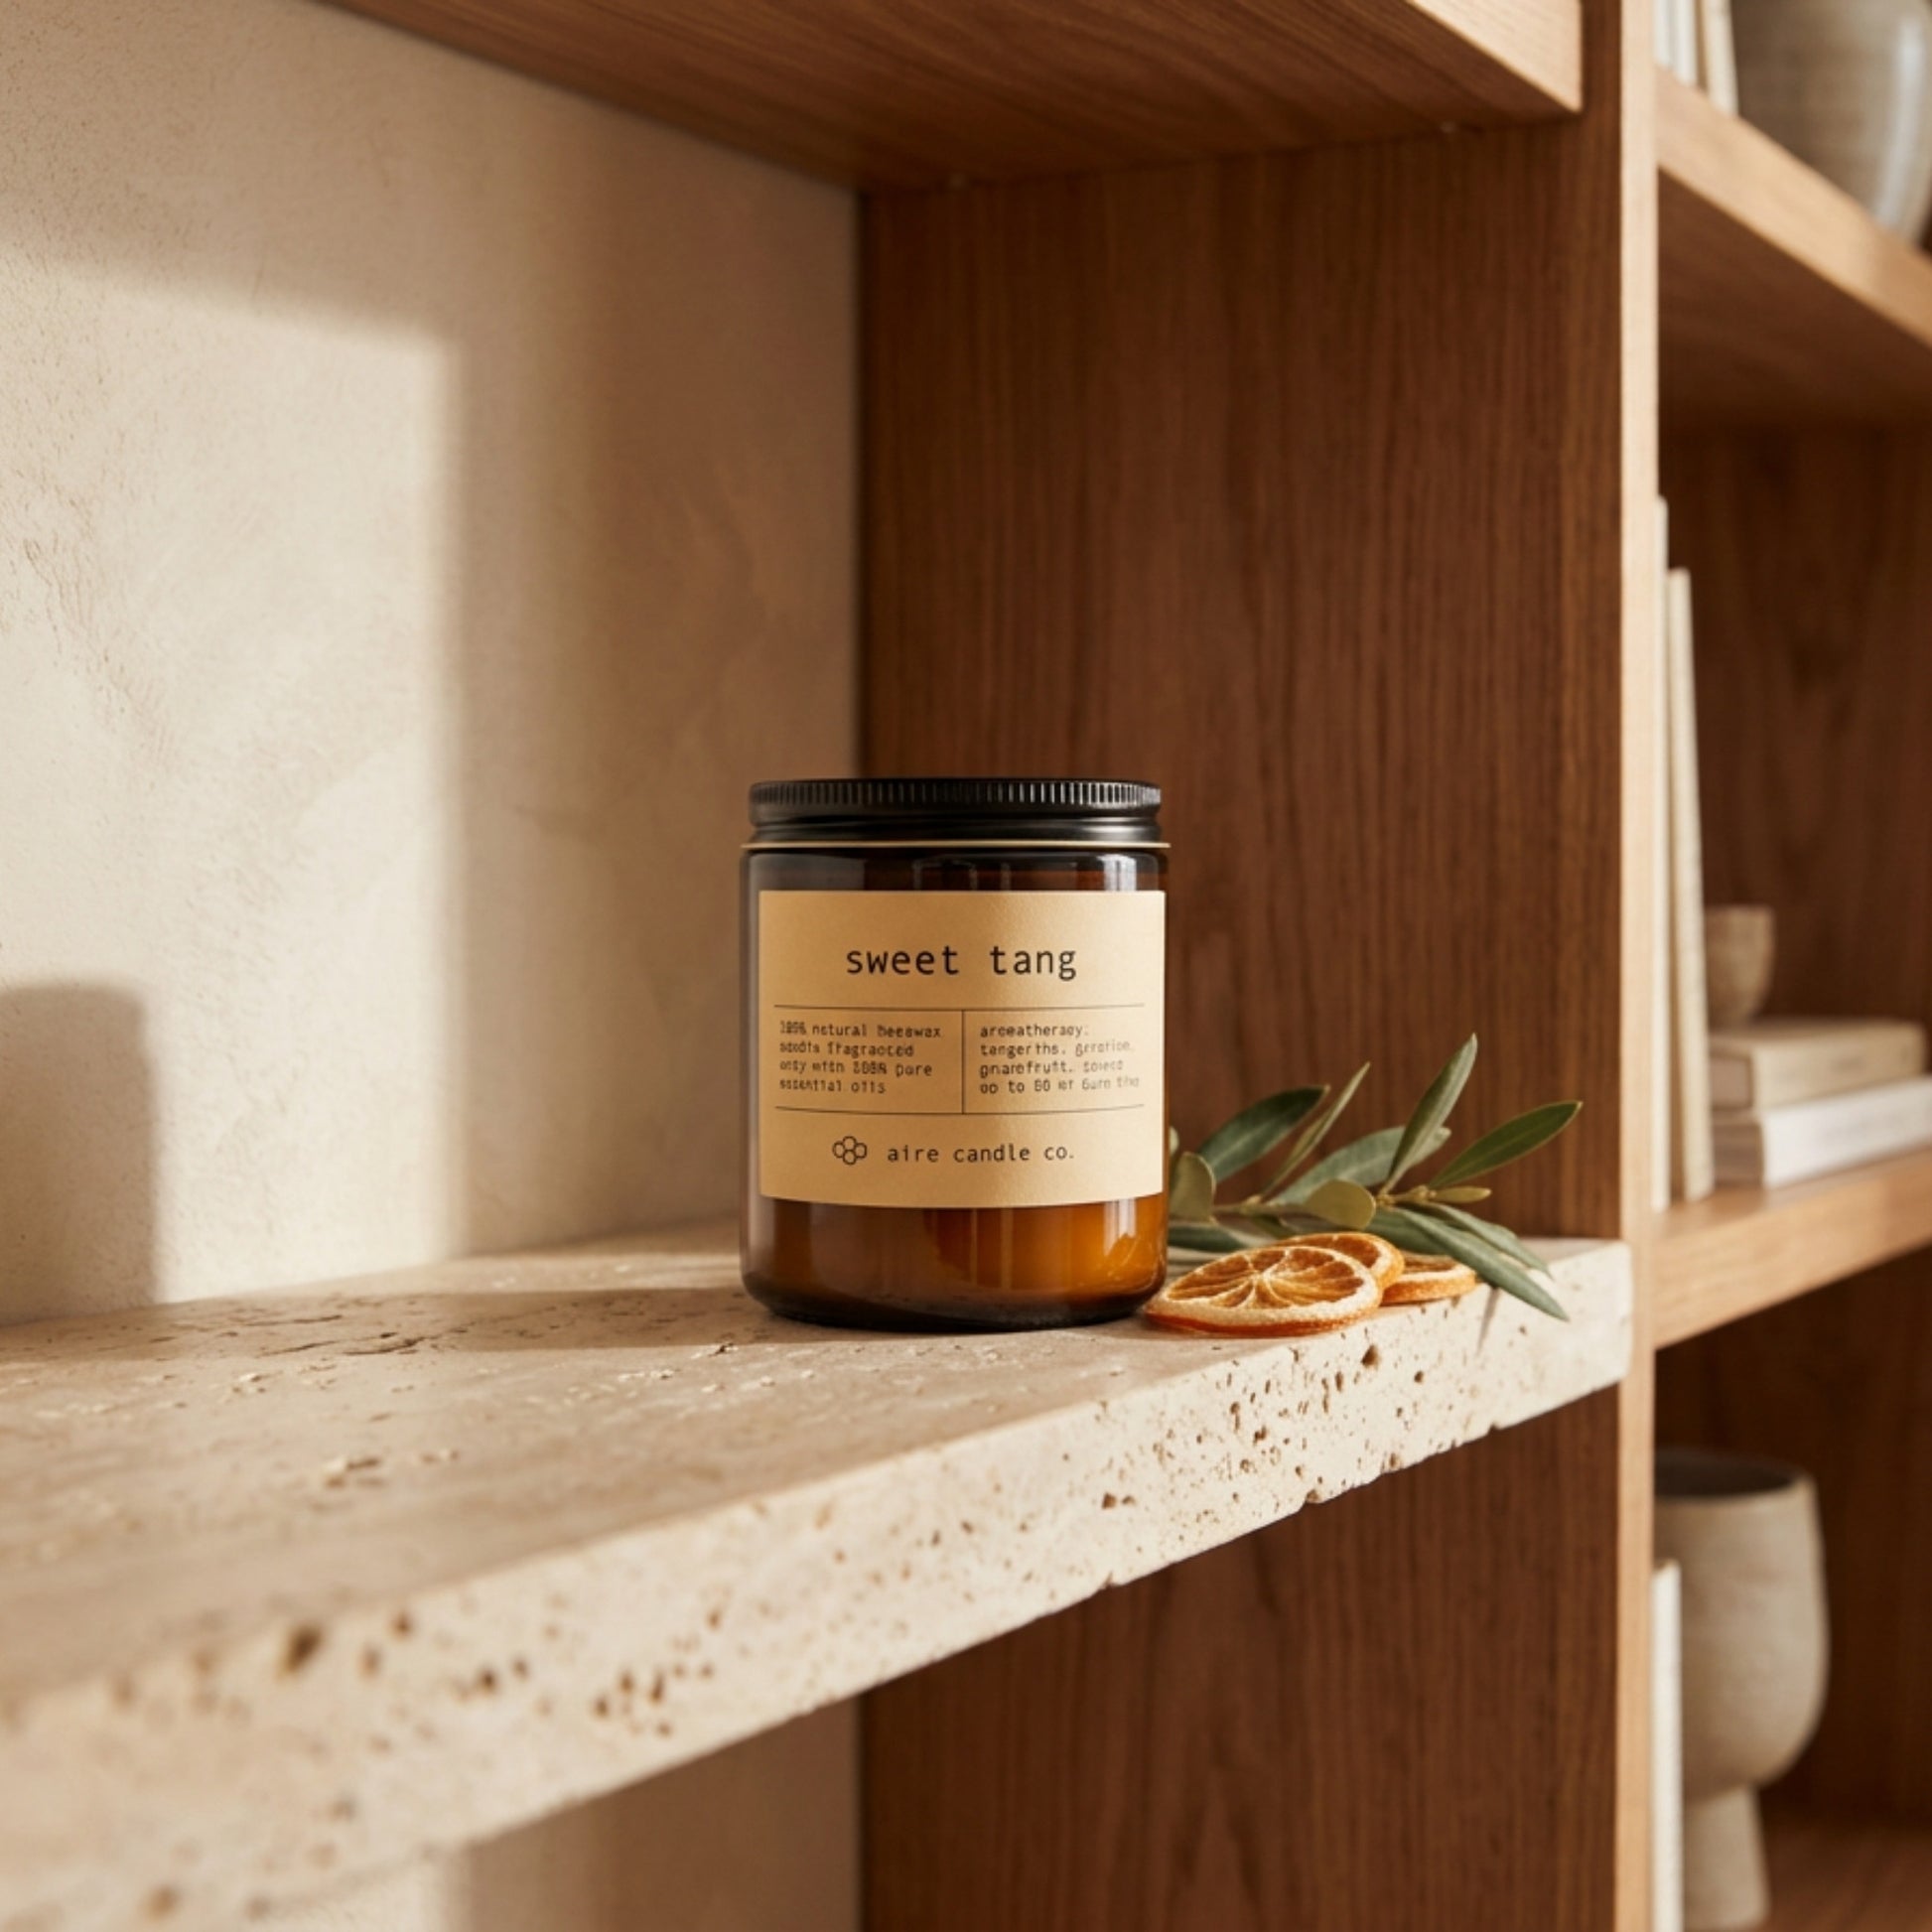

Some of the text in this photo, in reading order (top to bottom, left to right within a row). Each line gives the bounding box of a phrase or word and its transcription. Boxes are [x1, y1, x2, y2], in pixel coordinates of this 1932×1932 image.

[847, 944, 1078, 982] sweet tang
[887, 1143, 1075, 1164] aire candle co.
